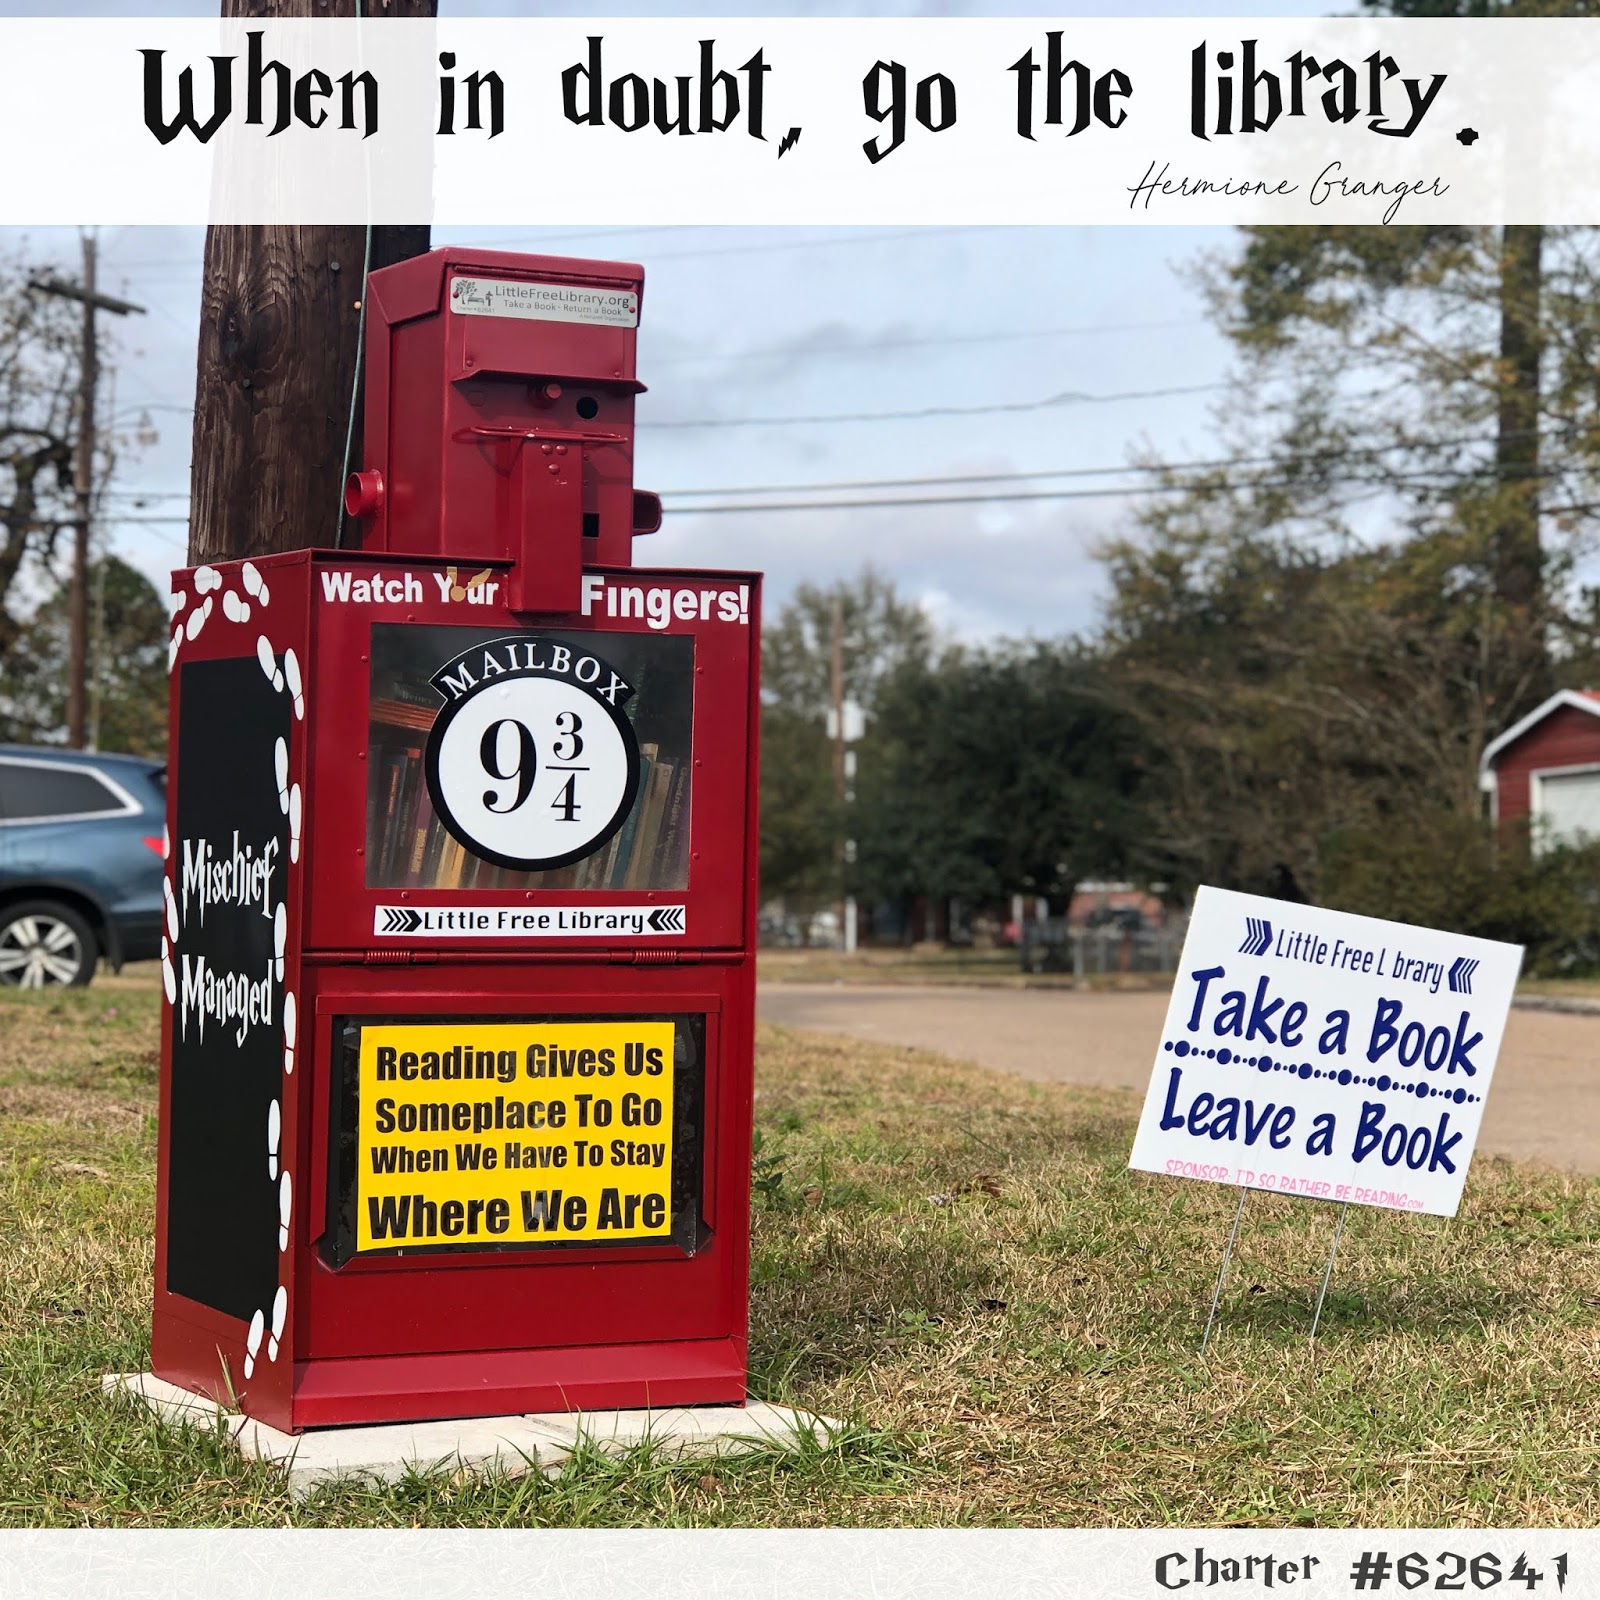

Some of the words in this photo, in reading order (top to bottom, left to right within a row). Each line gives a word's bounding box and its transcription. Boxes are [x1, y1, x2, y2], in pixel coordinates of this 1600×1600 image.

[503, 299, 524, 309] Take
[526, 302, 533, 310] a
[534, 301, 556, 311] Book
[563, 304, 592, 314] Return
[601, 306, 622, 316] Book
[320, 571, 423, 603] Watch
[581, 575, 749, 630] Fingers!
[440, 642, 629, 706] MAILBOX
[182, 829, 279, 928] Mischief
[424, 910, 489, 931] Little
[498, 910, 550, 931] Free
[558, 910, 644, 934] Library
[1275, 928, 1329, 965] Little
[1331, 939, 1374, 974] Free
[181, 954, 274, 1048] Managed
[1187, 966, 1308, 1048] Take
[1318, 1009, 1351, 1055] a
[1366, 997, 1484, 1077] Book
[376, 1045, 517, 1083] Reading
[525, 1043, 616, 1079] Gives
[623, 1042, 664, 1077] Us
[375, 1095, 567, 1134] Someplace
[574, 1093, 613, 1128] To
[621, 1092, 662, 1127] Go
[1159, 1067, 1296, 1150] Leave
[1305, 1113, 1336, 1156] a
[1351, 1100, 1463, 1175] Book
[371, 1145, 448, 1174] When
[455, 1143, 498, 1171] We
[504, 1142, 568, 1169] Have
[574, 1140, 604, 1167] To
[610, 1139, 666, 1168] Stay
[1235, 1168, 1255, 1185] I'D
[1258, 1173, 1276, 1188] SO
[1280, 1176, 1332, 1197] RATHER
[1335, 1184, 1353, 1200] BE
[368, 1194, 510, 1240] Where
[520, 1189, 588, 1233] We
[597, 1187, 666, 1230] Are
